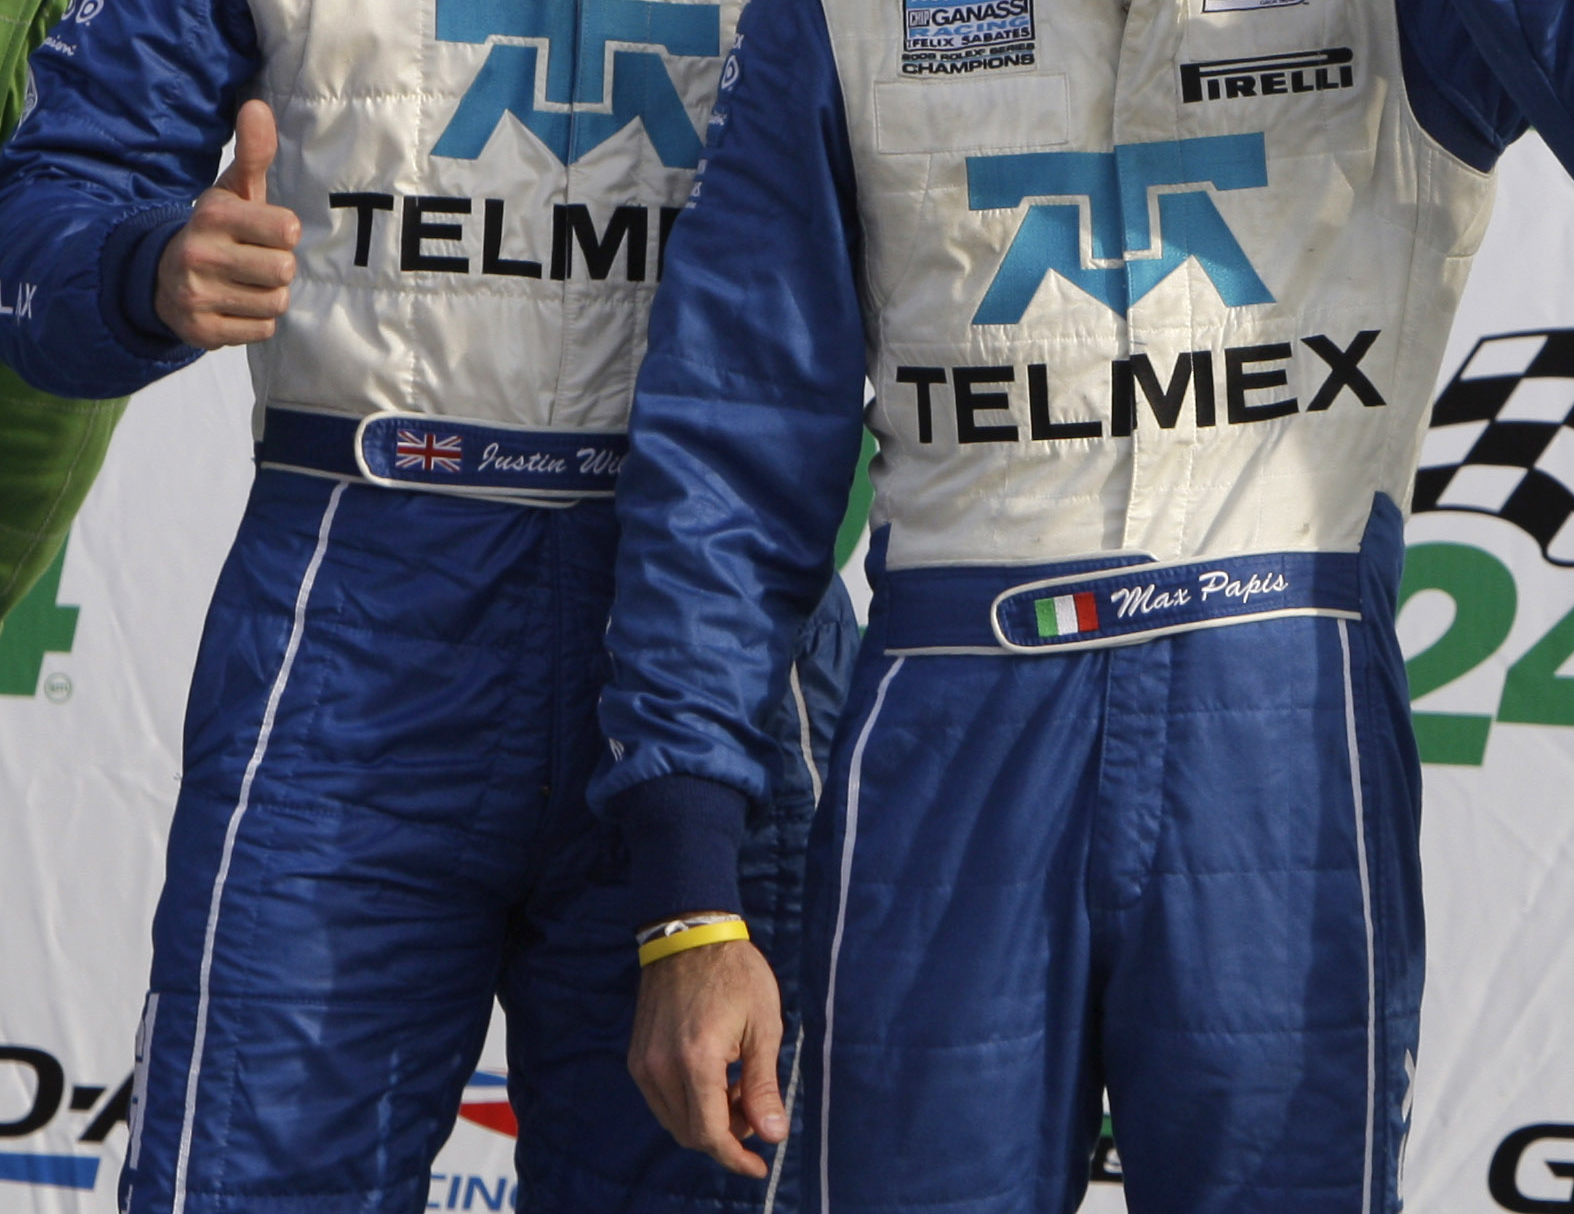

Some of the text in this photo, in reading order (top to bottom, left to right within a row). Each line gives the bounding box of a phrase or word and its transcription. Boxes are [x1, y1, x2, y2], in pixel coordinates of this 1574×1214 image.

[909, 16, 1029, 38] RACING
[912, 27, 1030, 48] FELIX SABATES
[989, 42, 1036, 56] SERIES
[901, 53, 1036, 75] CHAMPIONS
[1179, 47, 1354, 104] PIRELLI
[895, 328, 1387, 445] TELMEX
[477, 442, 566, 474] Justin
[1110, 569, 1289, 619] Max Papis
